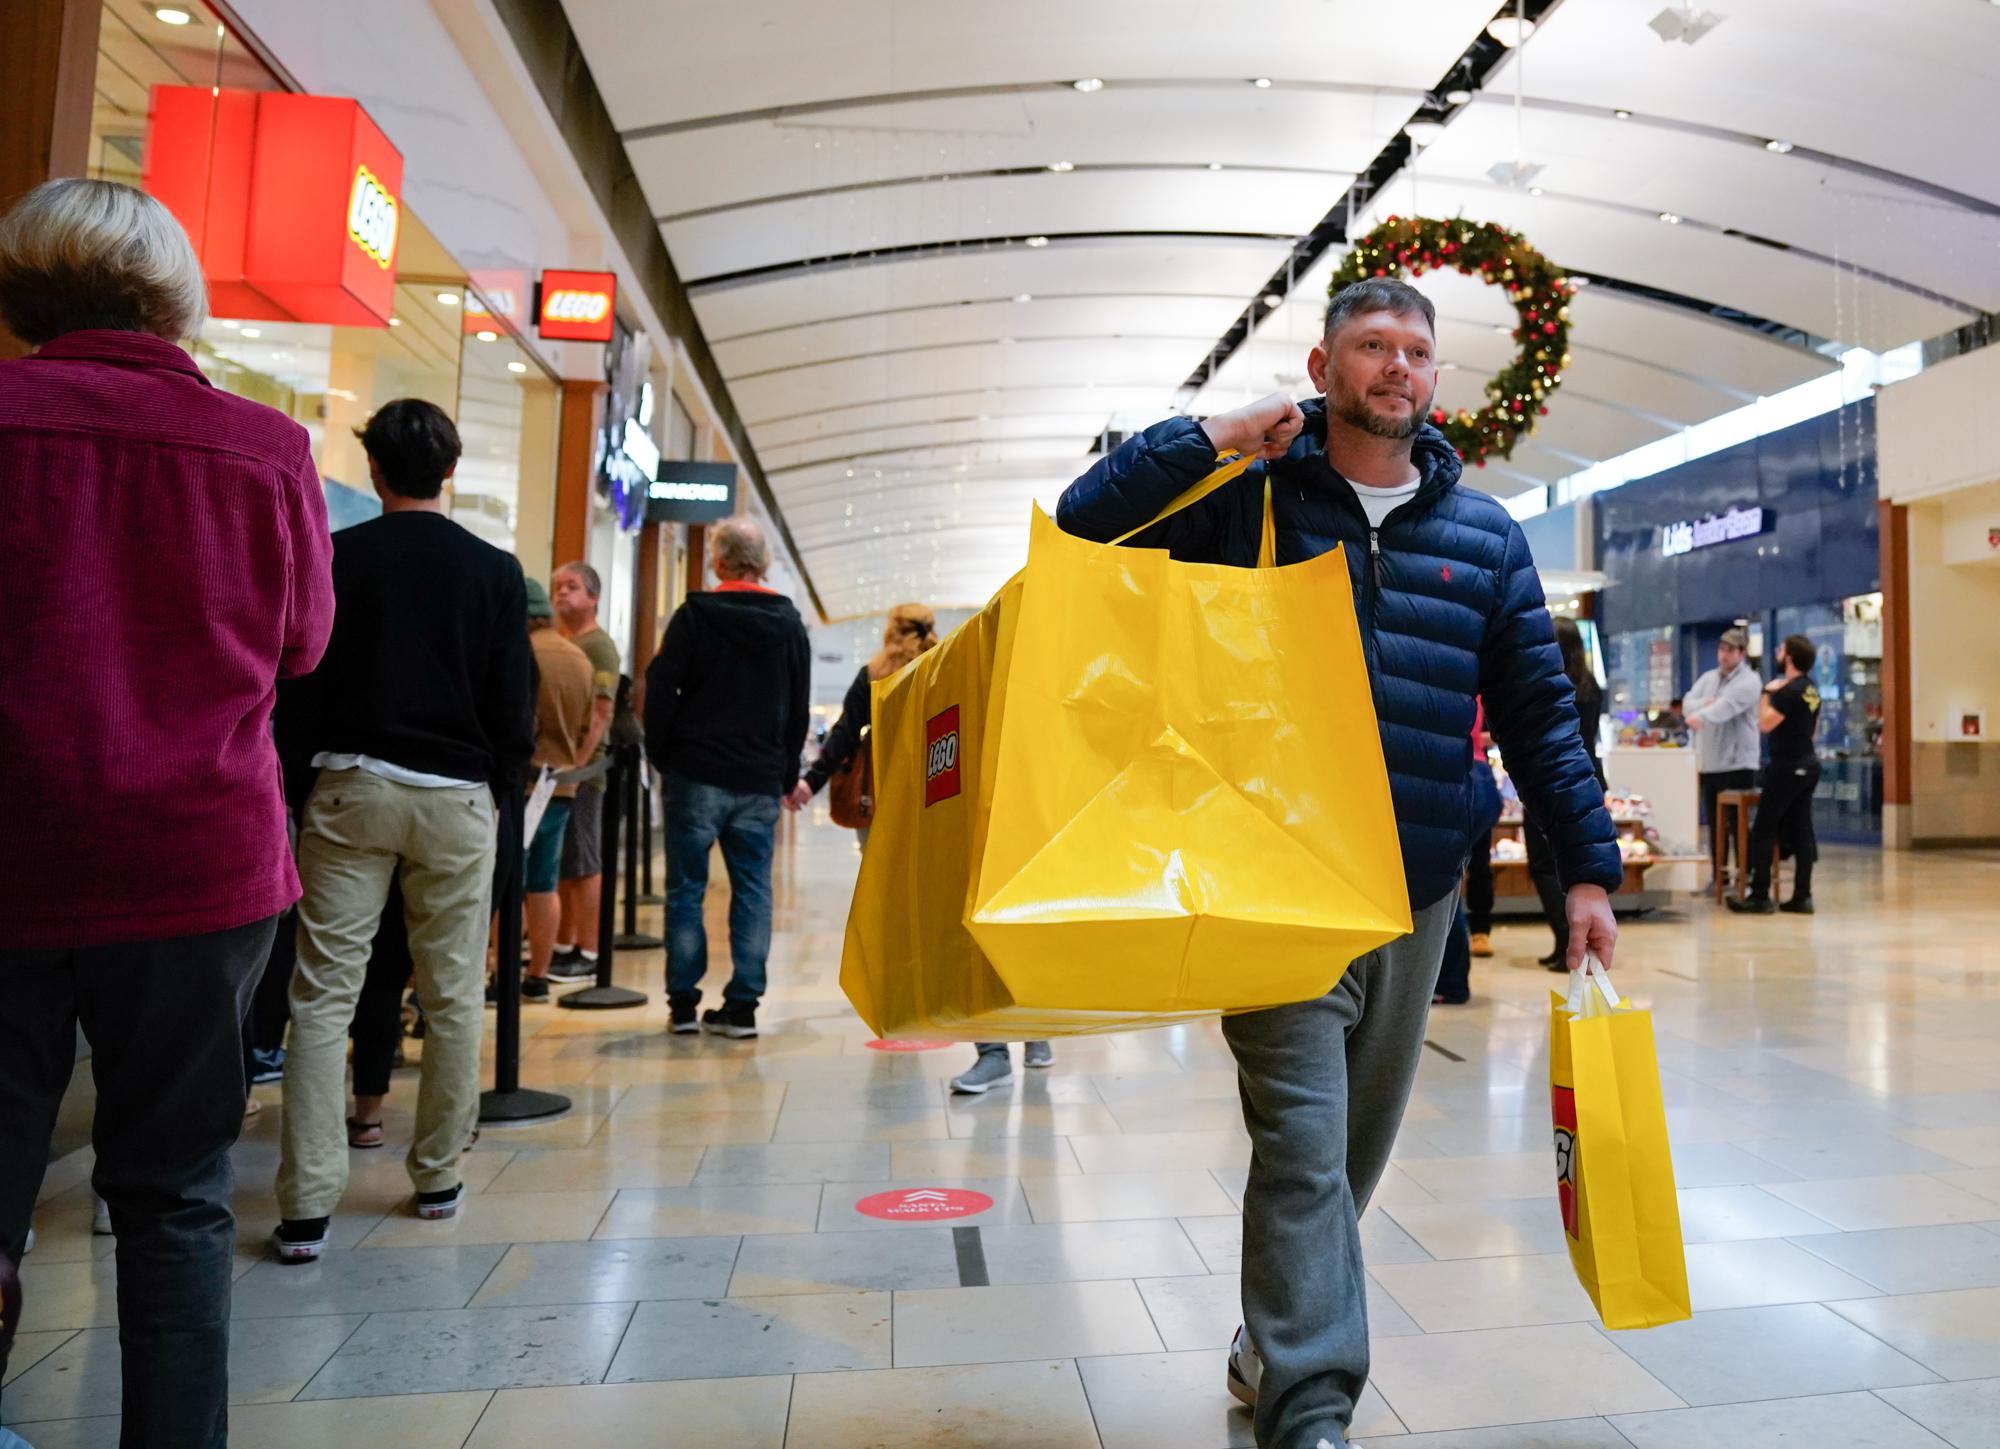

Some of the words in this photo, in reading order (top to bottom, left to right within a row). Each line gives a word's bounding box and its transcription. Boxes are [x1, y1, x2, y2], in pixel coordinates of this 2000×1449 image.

[348, 167, 398, 267] LEGO
[545, 290, 610, 322] LEGO
[927, 731, 959, 780] LEGO
